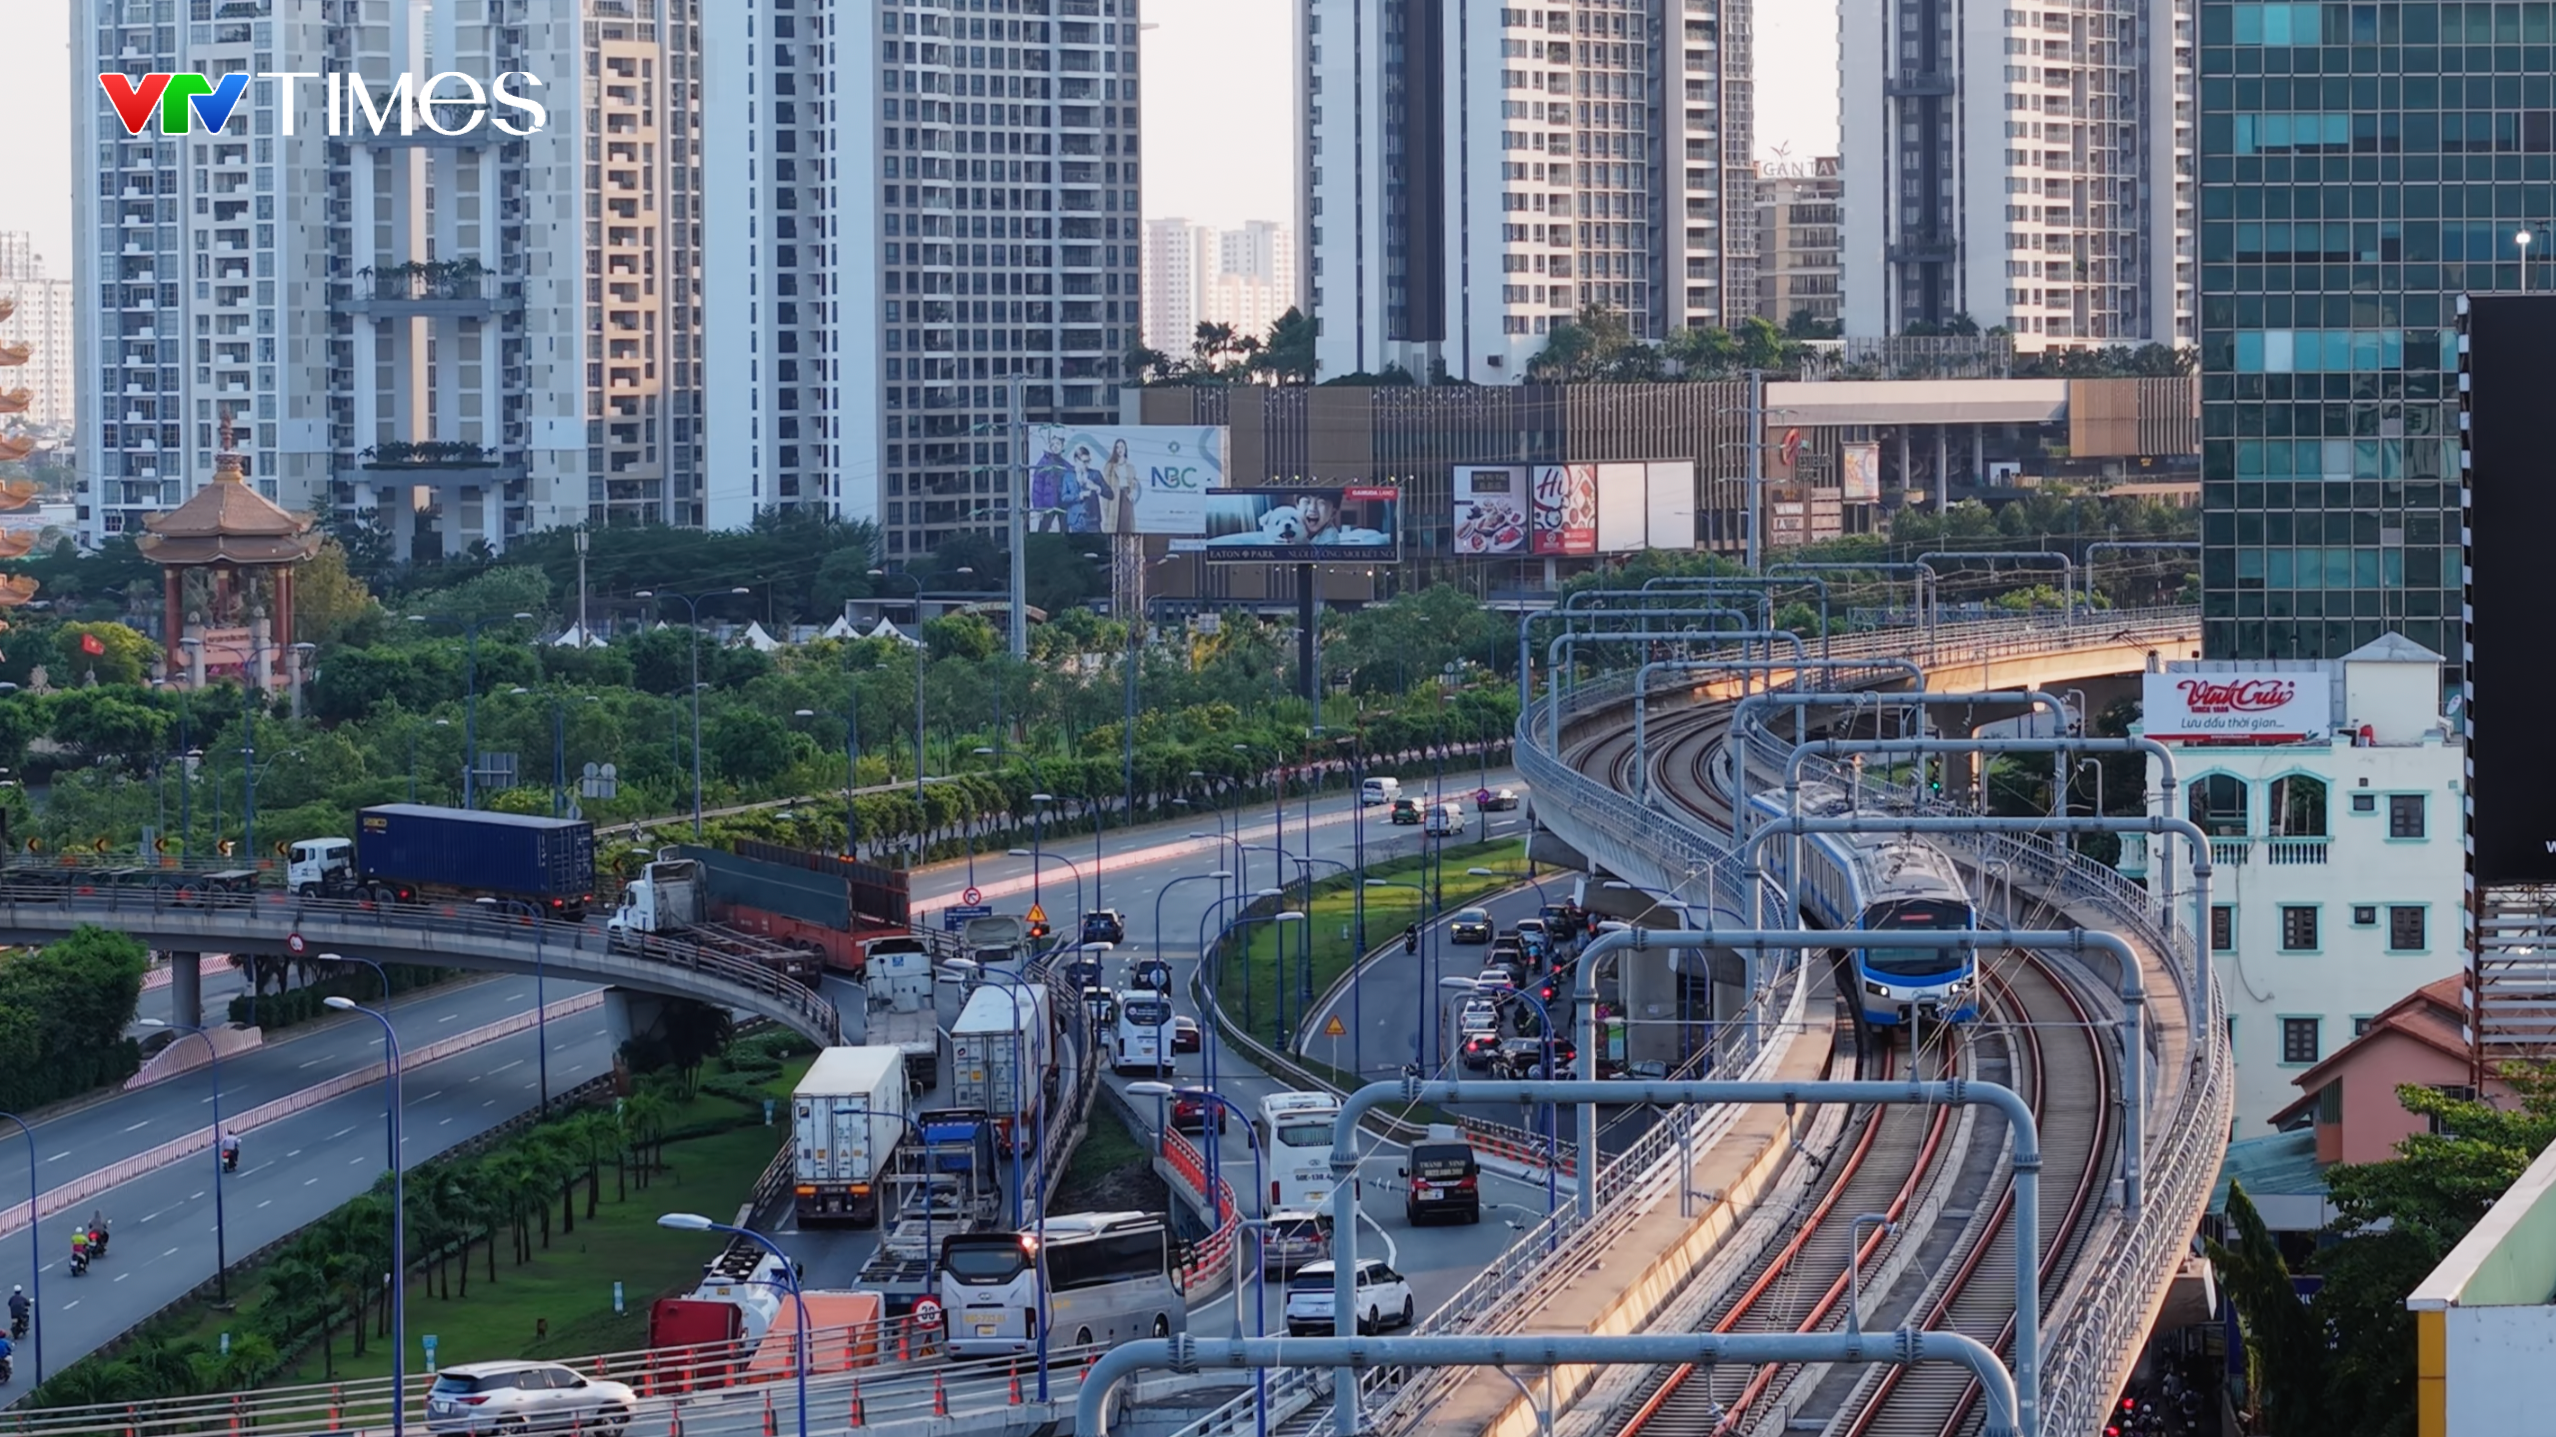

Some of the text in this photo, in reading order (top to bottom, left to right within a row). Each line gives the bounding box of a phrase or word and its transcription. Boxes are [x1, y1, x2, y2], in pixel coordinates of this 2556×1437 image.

[1151, 466, 1198, 489] NBC
[1536, 467, 1564, 500] Hi
[1209, 550, 1275, 559] EATON PARK
[2181, 717, 2202, 729] Lưu
